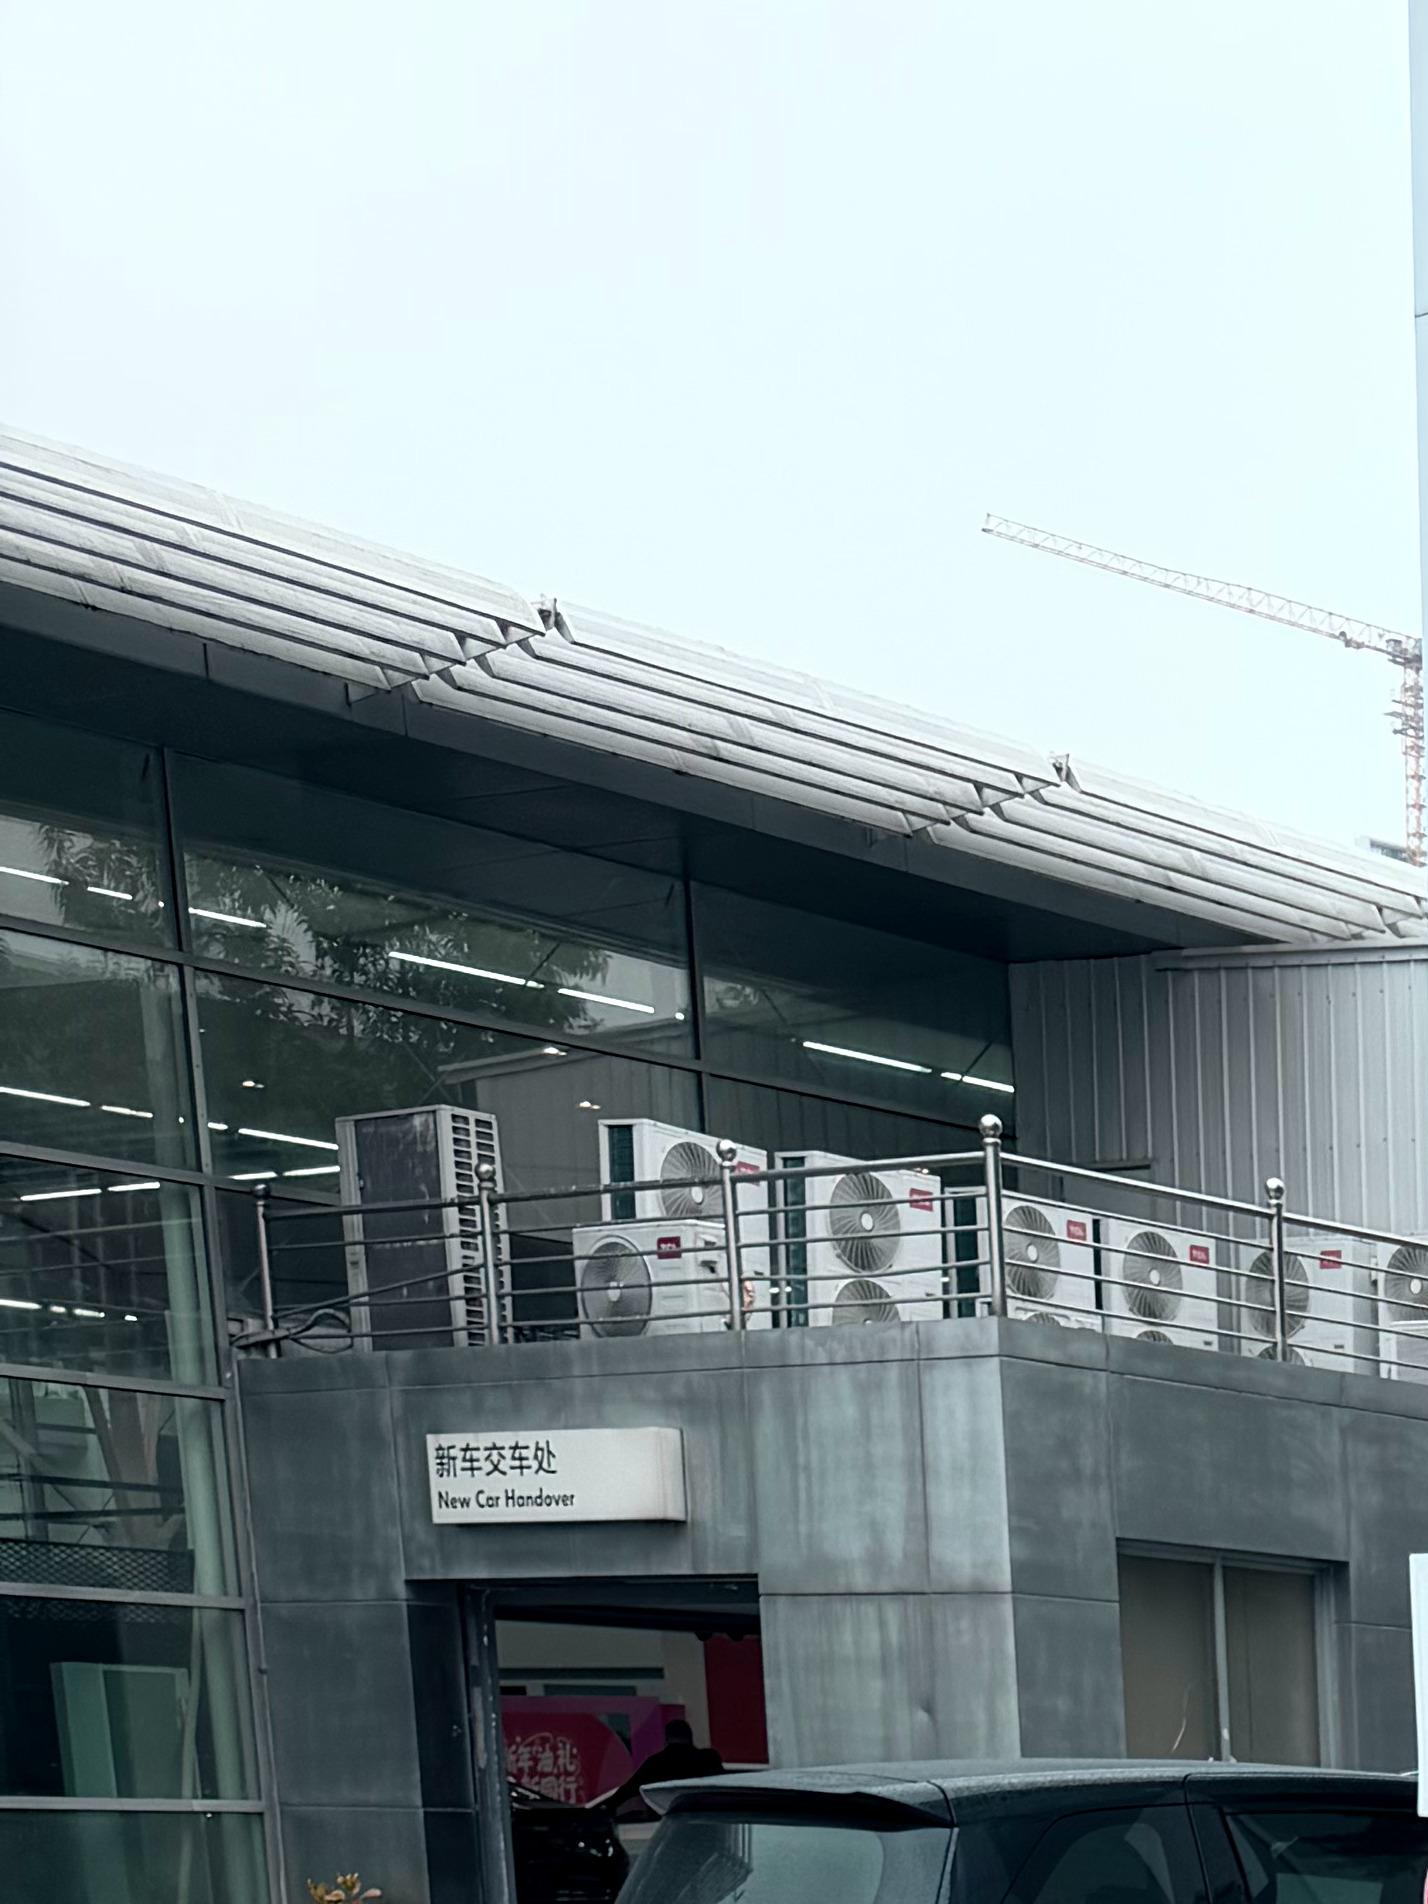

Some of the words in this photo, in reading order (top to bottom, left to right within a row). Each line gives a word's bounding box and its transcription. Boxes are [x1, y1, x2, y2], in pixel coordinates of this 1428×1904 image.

[435, 1440, 557, 1478] 新车交车处
[438, 1490, 471, 1509] New
[476, 1489, 500, 1508] Car
[505, 1487, 575, 1508] Handover
